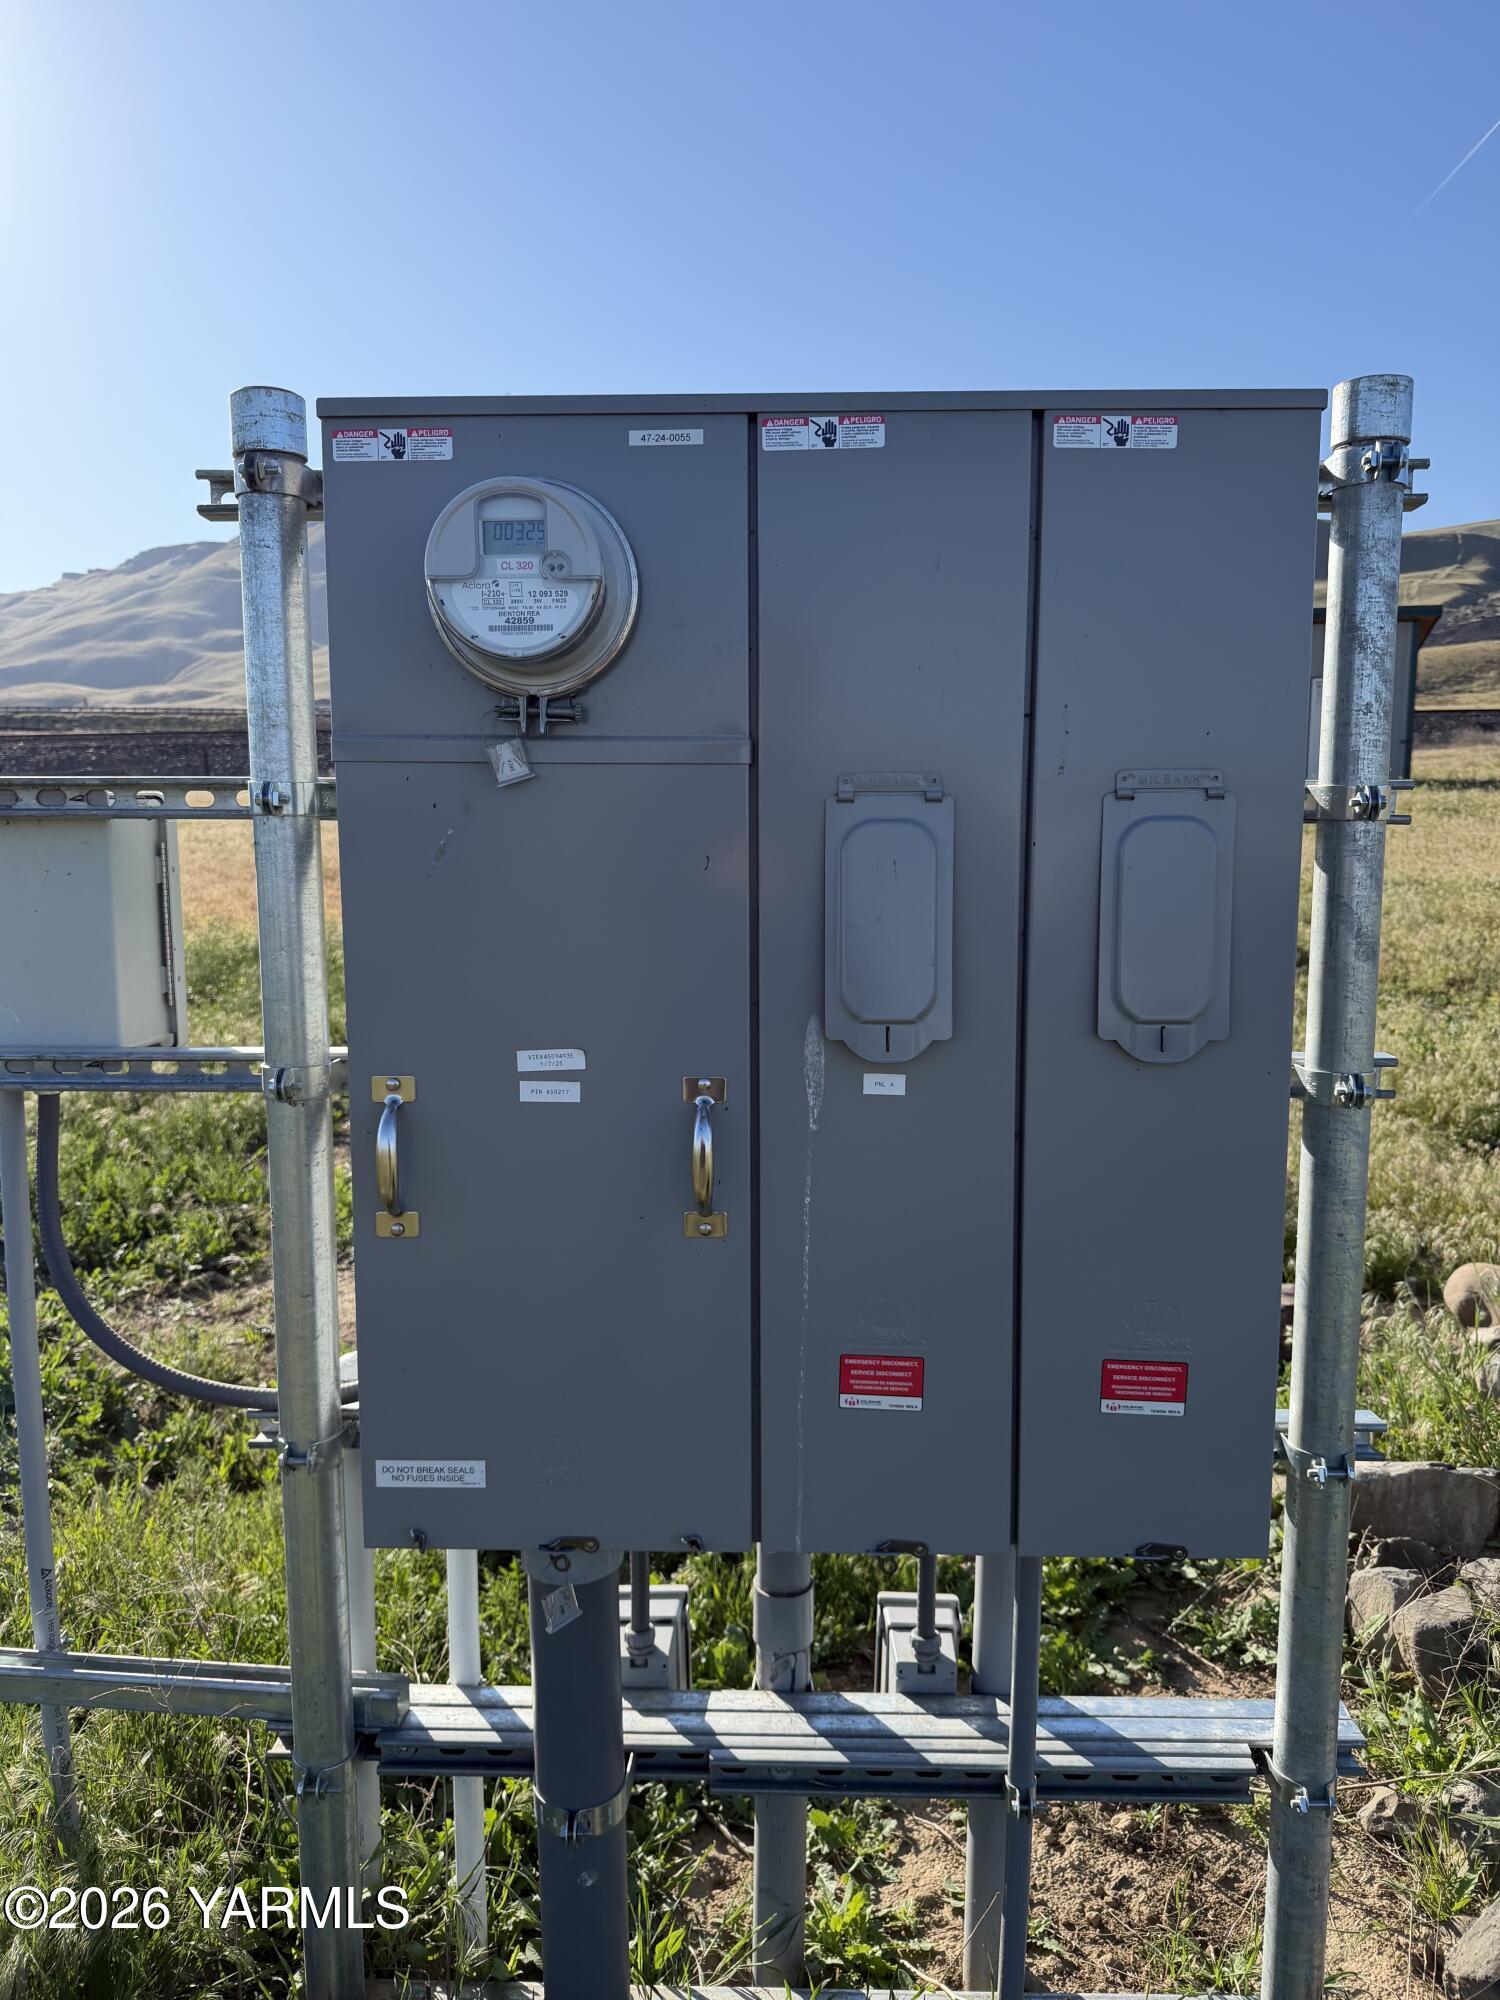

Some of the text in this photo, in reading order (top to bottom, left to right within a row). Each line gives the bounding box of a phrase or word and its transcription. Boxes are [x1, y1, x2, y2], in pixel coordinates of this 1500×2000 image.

[774, 418, 805, 426] DANGER
[851, 416, 882, 424] PELIGRO
[1144, 417, 1175, 425] PELIGRO
[343, 430, 374, 438] DANGER
[418, 429, 449, 437] PELIGRO
[641, 433, 691, 442] 47-24-0055
[501, 561, 534, 570] CL 320
[382, 1466, 475, 1474] DO NOT BREAK SEALS
[391, 1474, 465, 1482] NO FUSES INSIDE
[48, 1618, 58, 1652] Heritag
